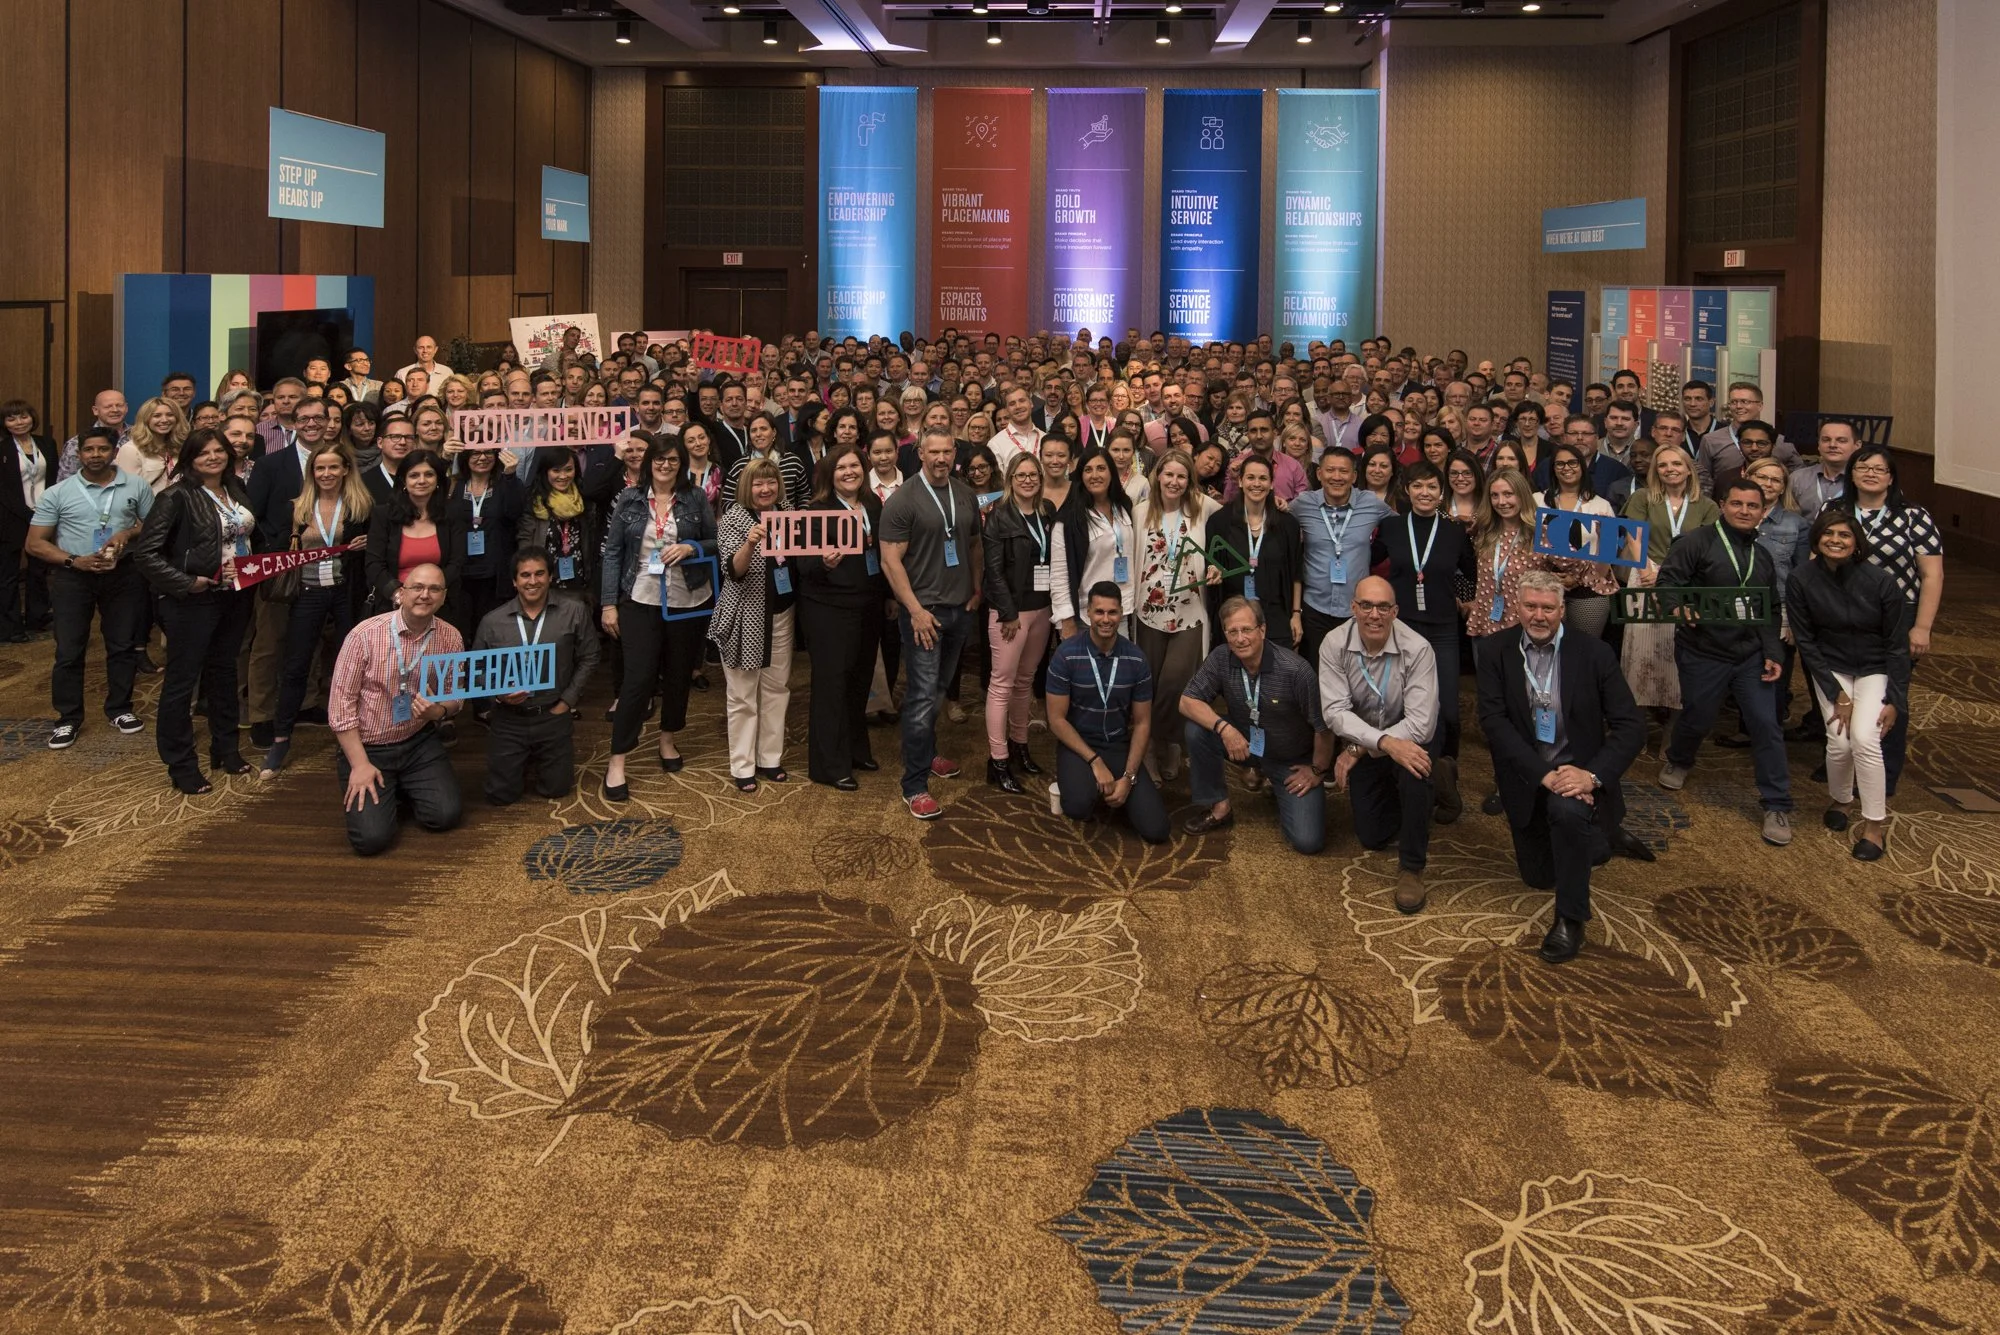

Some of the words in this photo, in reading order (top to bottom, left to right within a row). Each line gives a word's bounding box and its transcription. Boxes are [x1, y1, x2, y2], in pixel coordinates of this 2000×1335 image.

[279, 164, 302, 185] STEP
[304, 168, 317, 187] UP
[279, 186, 309, 208] HEADS
[311, 191, 324, 209] UP
[828, 192, 895, 206] EMPOWERING
[942, 193, 983, 207] VIBRANT
[1055, 194, 1080, 208] BOLD
[1171, 195, 1219, 210] INTUITIVE
[1285, 196, 1331, 210] DYNAMIC
[828, 207, 887, 221] LEADERSHIP
[942, 209, 1010, 223] PLACEMAKING
[1055, 209, 1096, 223] GROWTH
[1171, 210, 1213, 225] SERVICE
[1285, 211, 1362, 226] RELATIONSHIPS
[1574, 231, 1580, 244] AT
[1592, 229, 1605, 242] BEST
[1727, 252, 1738, 266] EXIT
[827, 290, 886, 305] LEADERSHIP
[940, 292, 982, 306] ESPACES
[1053, 293, 1115, 308] CROISSANCE
[1169, 294, 1211, 309] SERVICE
[1283, 296, 1337, 311] RELATIONS
[940, 307, 987, 322] VIBRANTS
[1053, 308, 1114, 323] AUDACIEUSE
[1169, 309, 1210, 324] INTUITIF
[1283, 311, 1348, 328] DYNAMIQUES
[700, 336, 754, 371] 2017
[464, 410, 622, 446] CONFERENCE
[771, 515, 853, 550] HELLO
[261, 549, 330, 576] CANADA
[434, 648, 545, 697] YEEHAW
